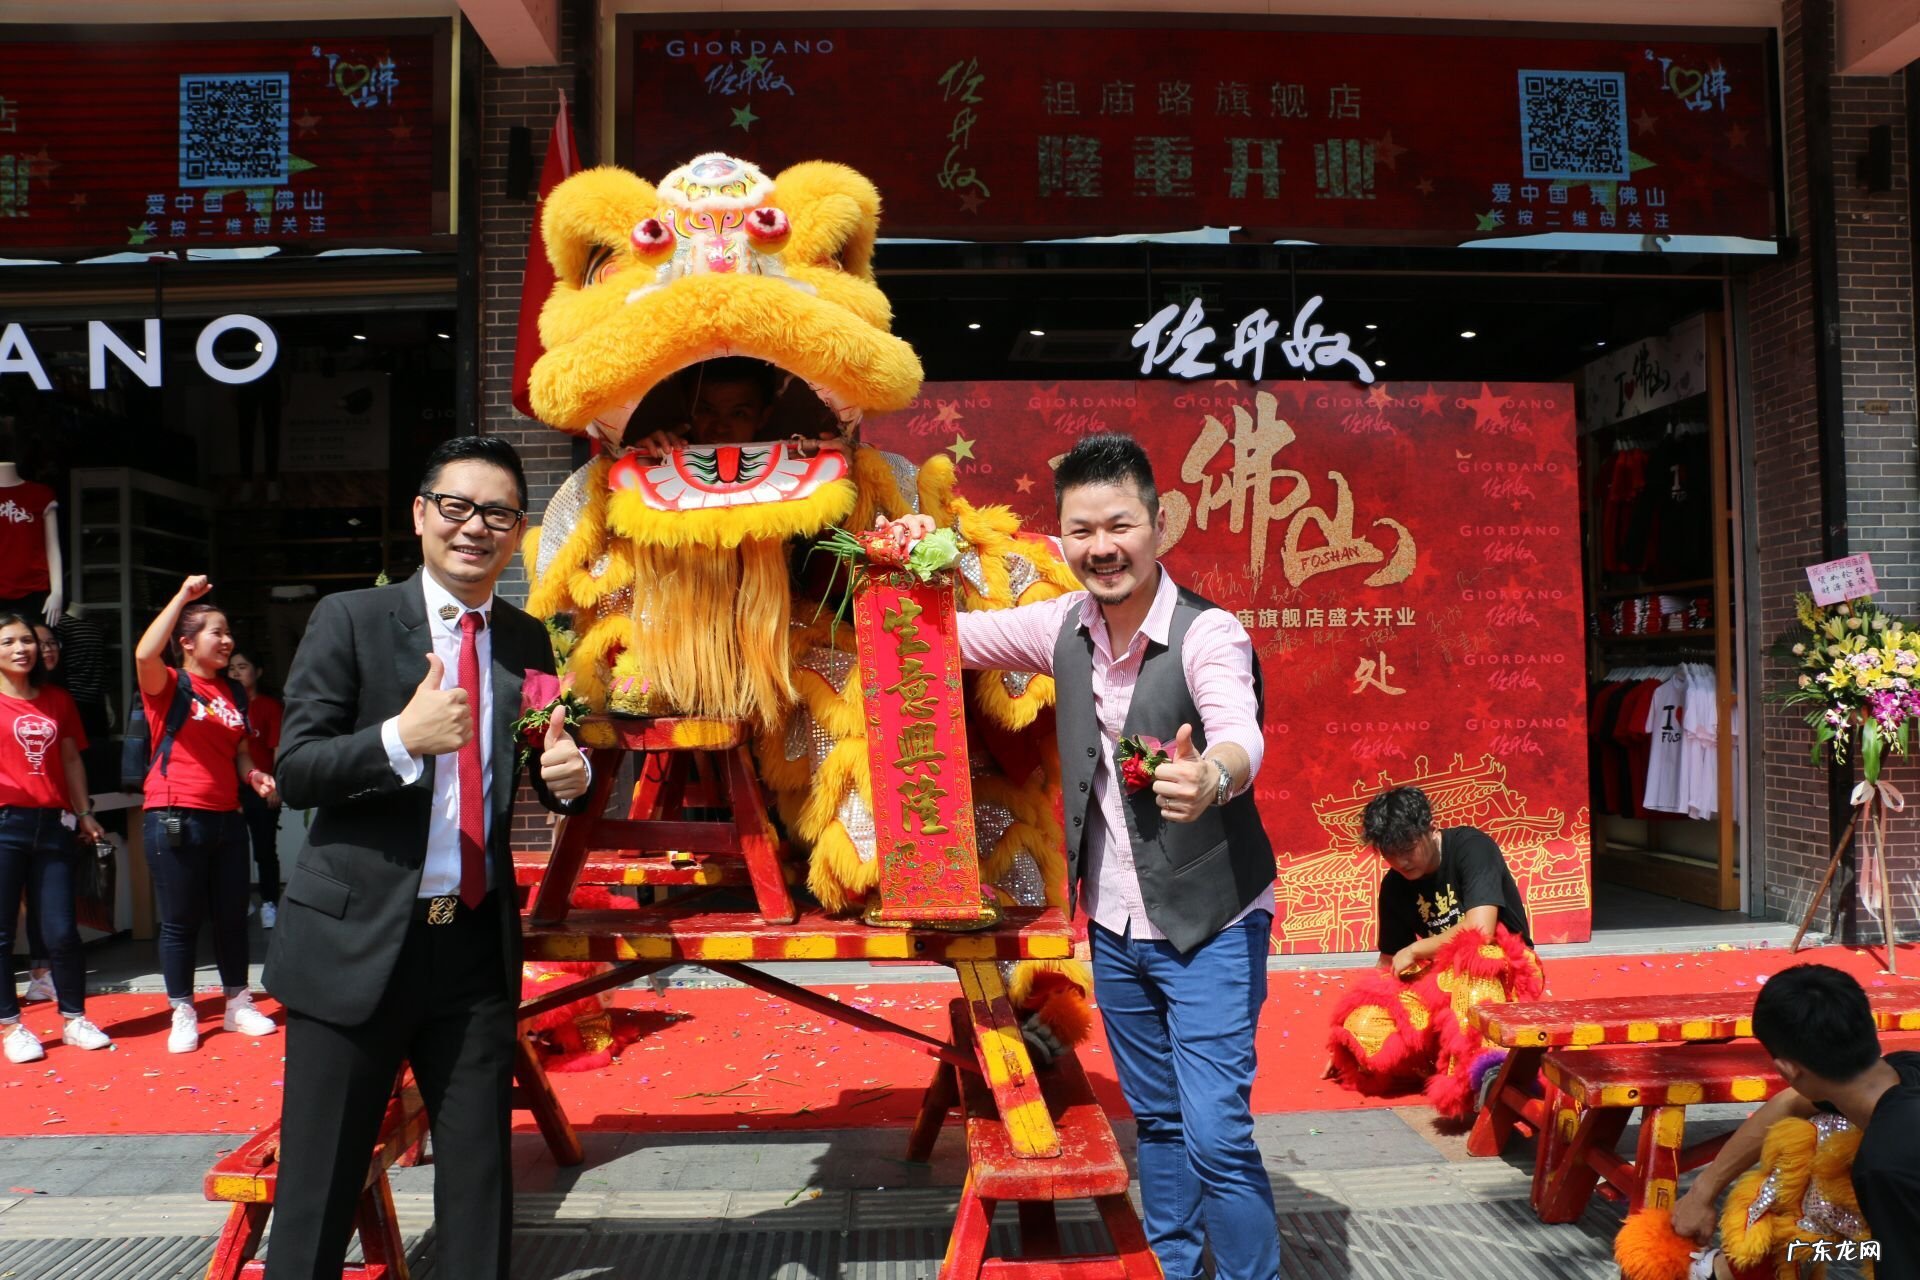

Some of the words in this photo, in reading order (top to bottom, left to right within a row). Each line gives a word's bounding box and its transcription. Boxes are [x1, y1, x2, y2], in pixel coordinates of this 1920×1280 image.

[666, 40, 834, 57] GIORDANO
[1042, 79, 1362, 119] 祖庙路旗舰店
[1037, 135, 1377, 199] 隆重开业
[1491, 183, 1568, 205] 爱中国
[146, 193, 224, 216] 爱中国
[1490, 209, 1669, 229] 长按二维码关注
[0, 313, 278, 390] ANO
[1028, 398, 1137, 409] GIORDANO
[1174, 396, 1251, 409] GIORDA
[1316, 396, 1420, 410] GIORDANO
[1455, 397, 1555, 409] GDANO
[1457, 461, 1558, 473] GIORDANO
[1181, 390, 1417, 596] 佛山
[1460, 525, 1560, 537] GIORDANO
[1300, 546, 1361, 572] FOSHAN
[1462, 589, 1563, 601] GIORDANO
[1464, 653, 1565, 666] GIORDANO
[1352, 650, 1407, 695] 处
[882, 596, 949, 836] 生意興隆
[1465, 718, 1568, 731] GIORDANO
[1325, 720, 1431, 734] GIORDANO
